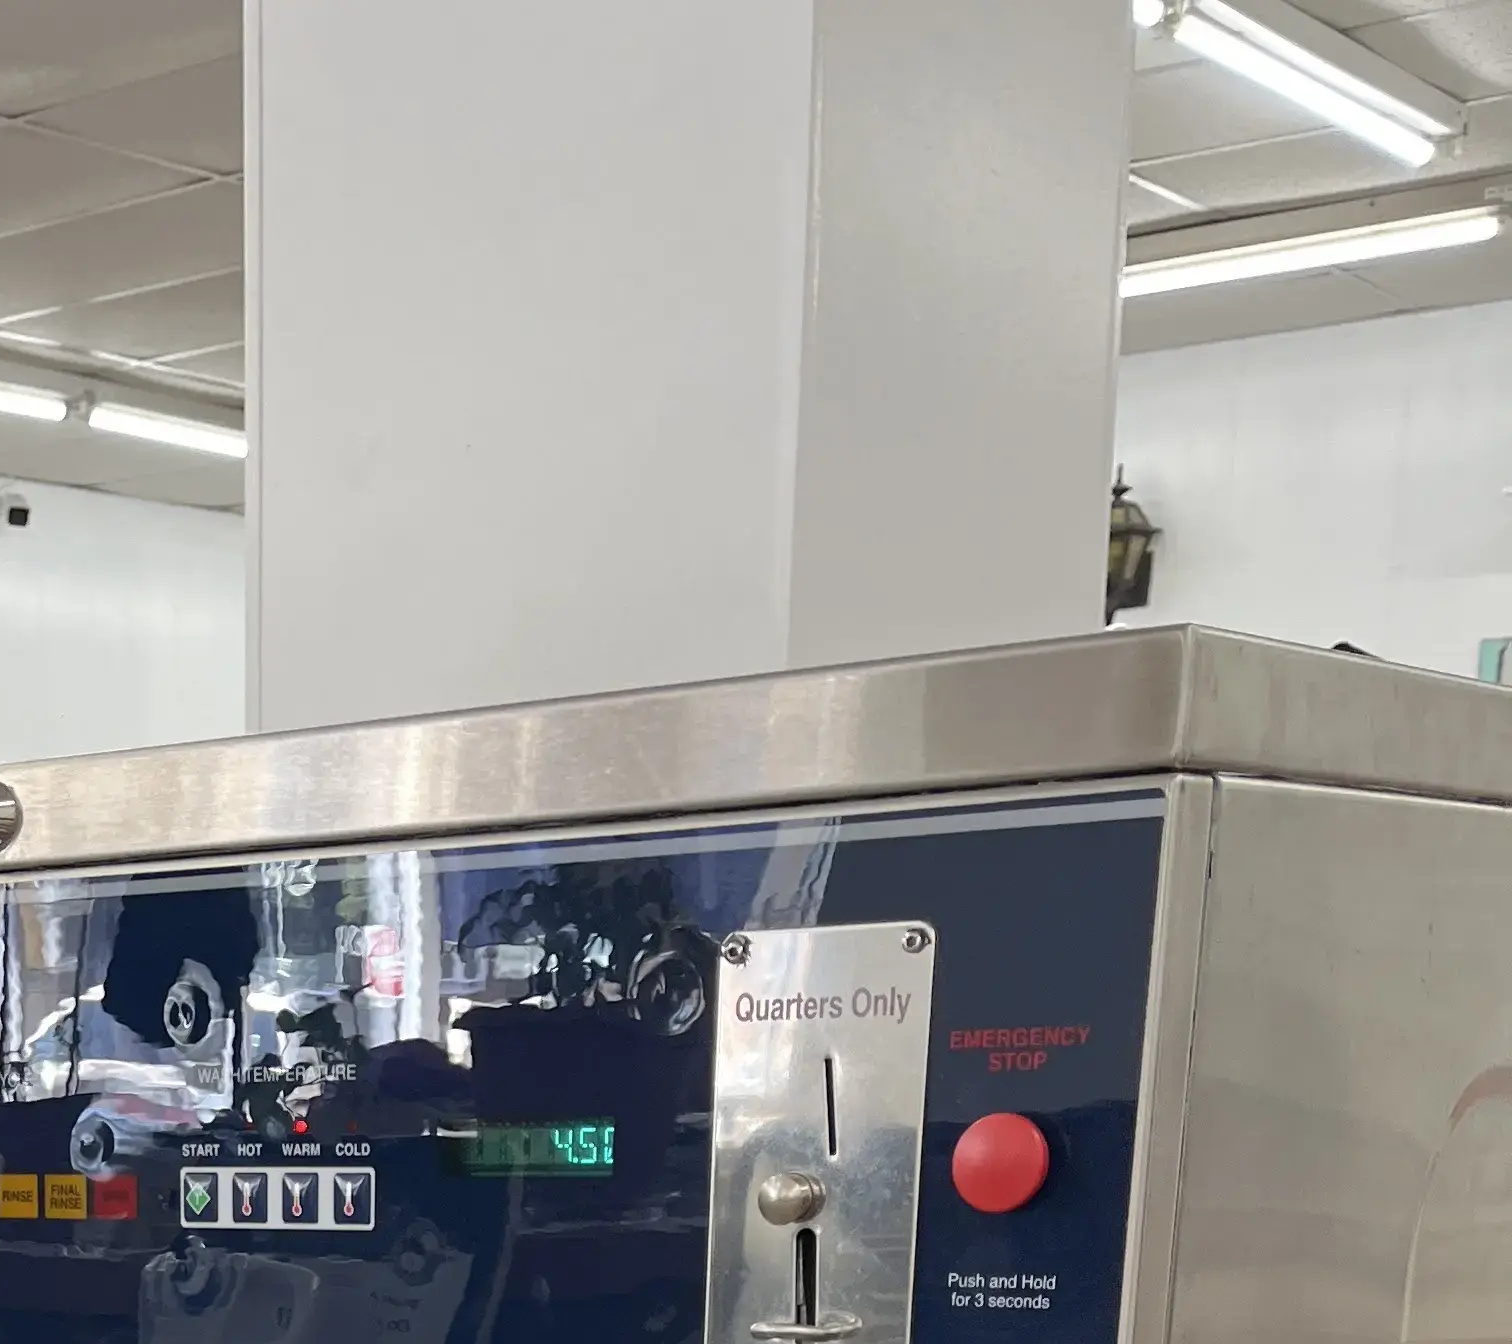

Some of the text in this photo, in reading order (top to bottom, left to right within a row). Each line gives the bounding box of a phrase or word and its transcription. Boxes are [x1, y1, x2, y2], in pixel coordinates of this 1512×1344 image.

[735, 986, 912, 1025] Quarters Only
[949, 1025, 1090, 1049] EMERGENCY
[989, 1050, 1047, 1072] STOP
[245, 1064, 357, 1083] TEMPERATURE
[182, 1143, 370, 1157] START HOT WARM COLD
[1, 1190, 34, 1202] RINSE
[50, 1184, 81, 1196] FINAL
[50, 1197, 82, 1209] RINSE
[947, 1272, 1057, 1290] Push and Hold
[951, 1291, 1050, 1310] for 3 seconds
